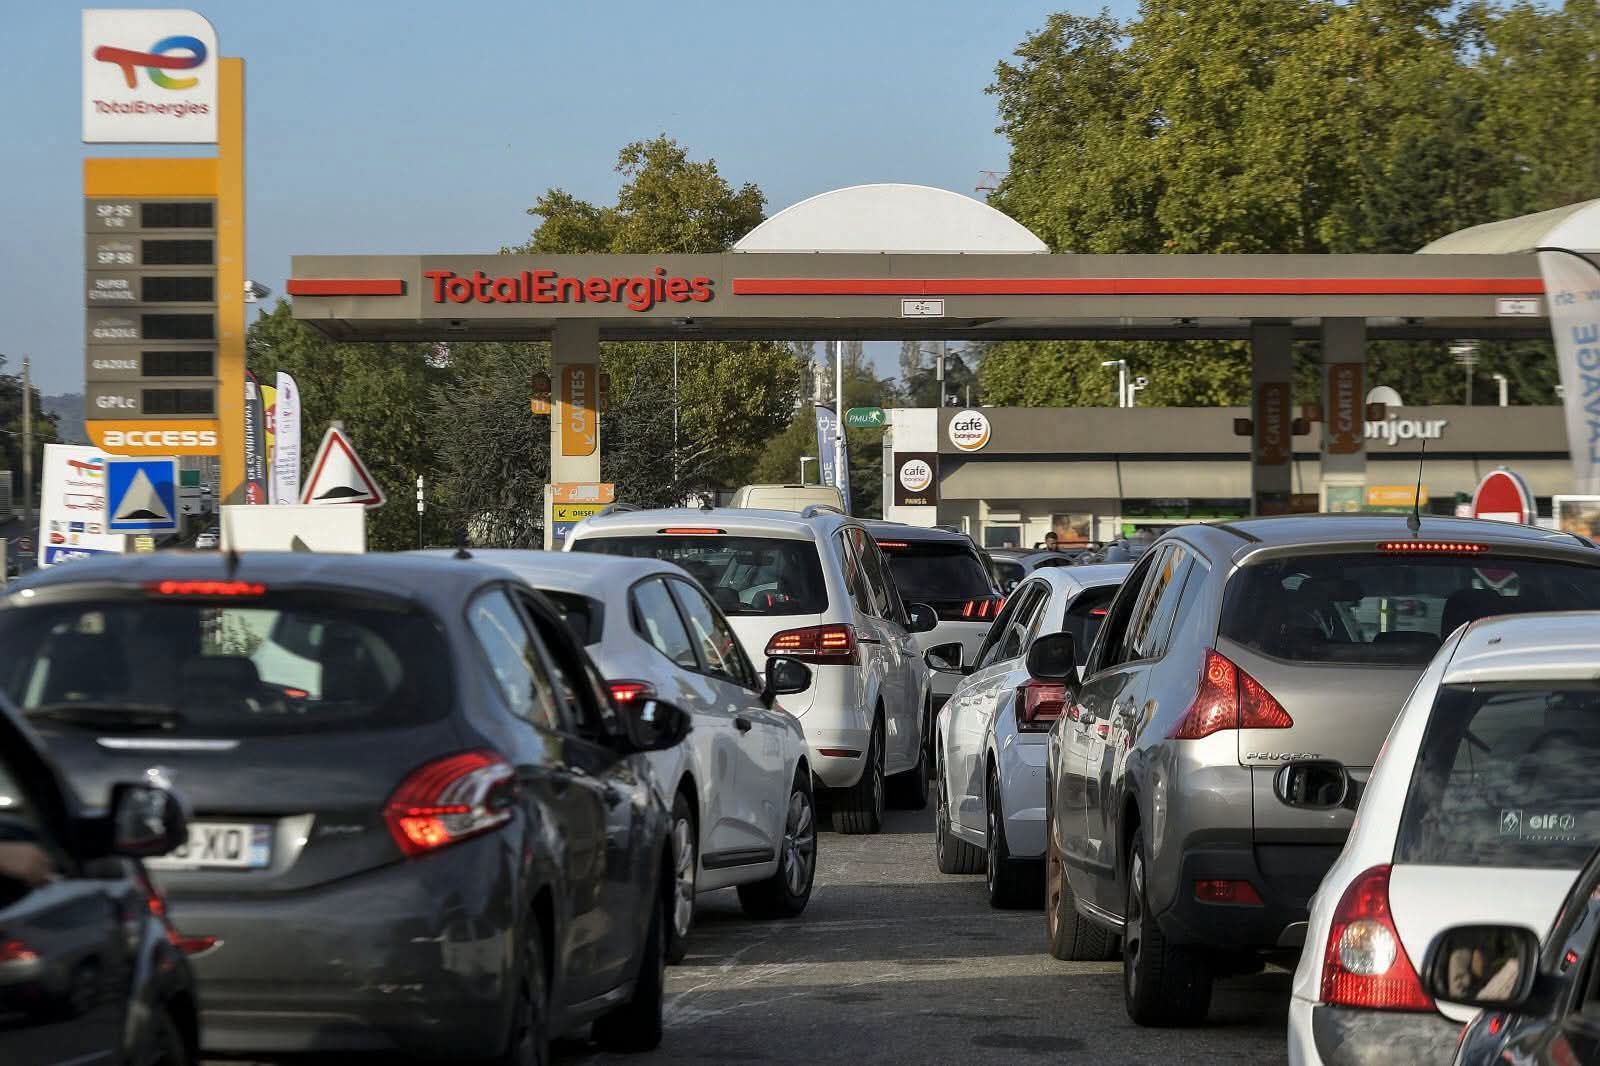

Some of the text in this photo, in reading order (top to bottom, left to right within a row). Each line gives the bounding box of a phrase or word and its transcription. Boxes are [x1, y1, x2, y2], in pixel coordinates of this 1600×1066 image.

[93, 99, 209, 118] TotalEnergies
[424, 267, 714, 312] TotalEnergies
[570, 369, 585, 433] CARTES
[955, 418, 982, 431] café
[1364, 413, 1447, 445] njour
[104, 431, 217, 446] access
[904, 465, 926, 475] café
[1246, 752, 1322, 761] PEUGEOT
